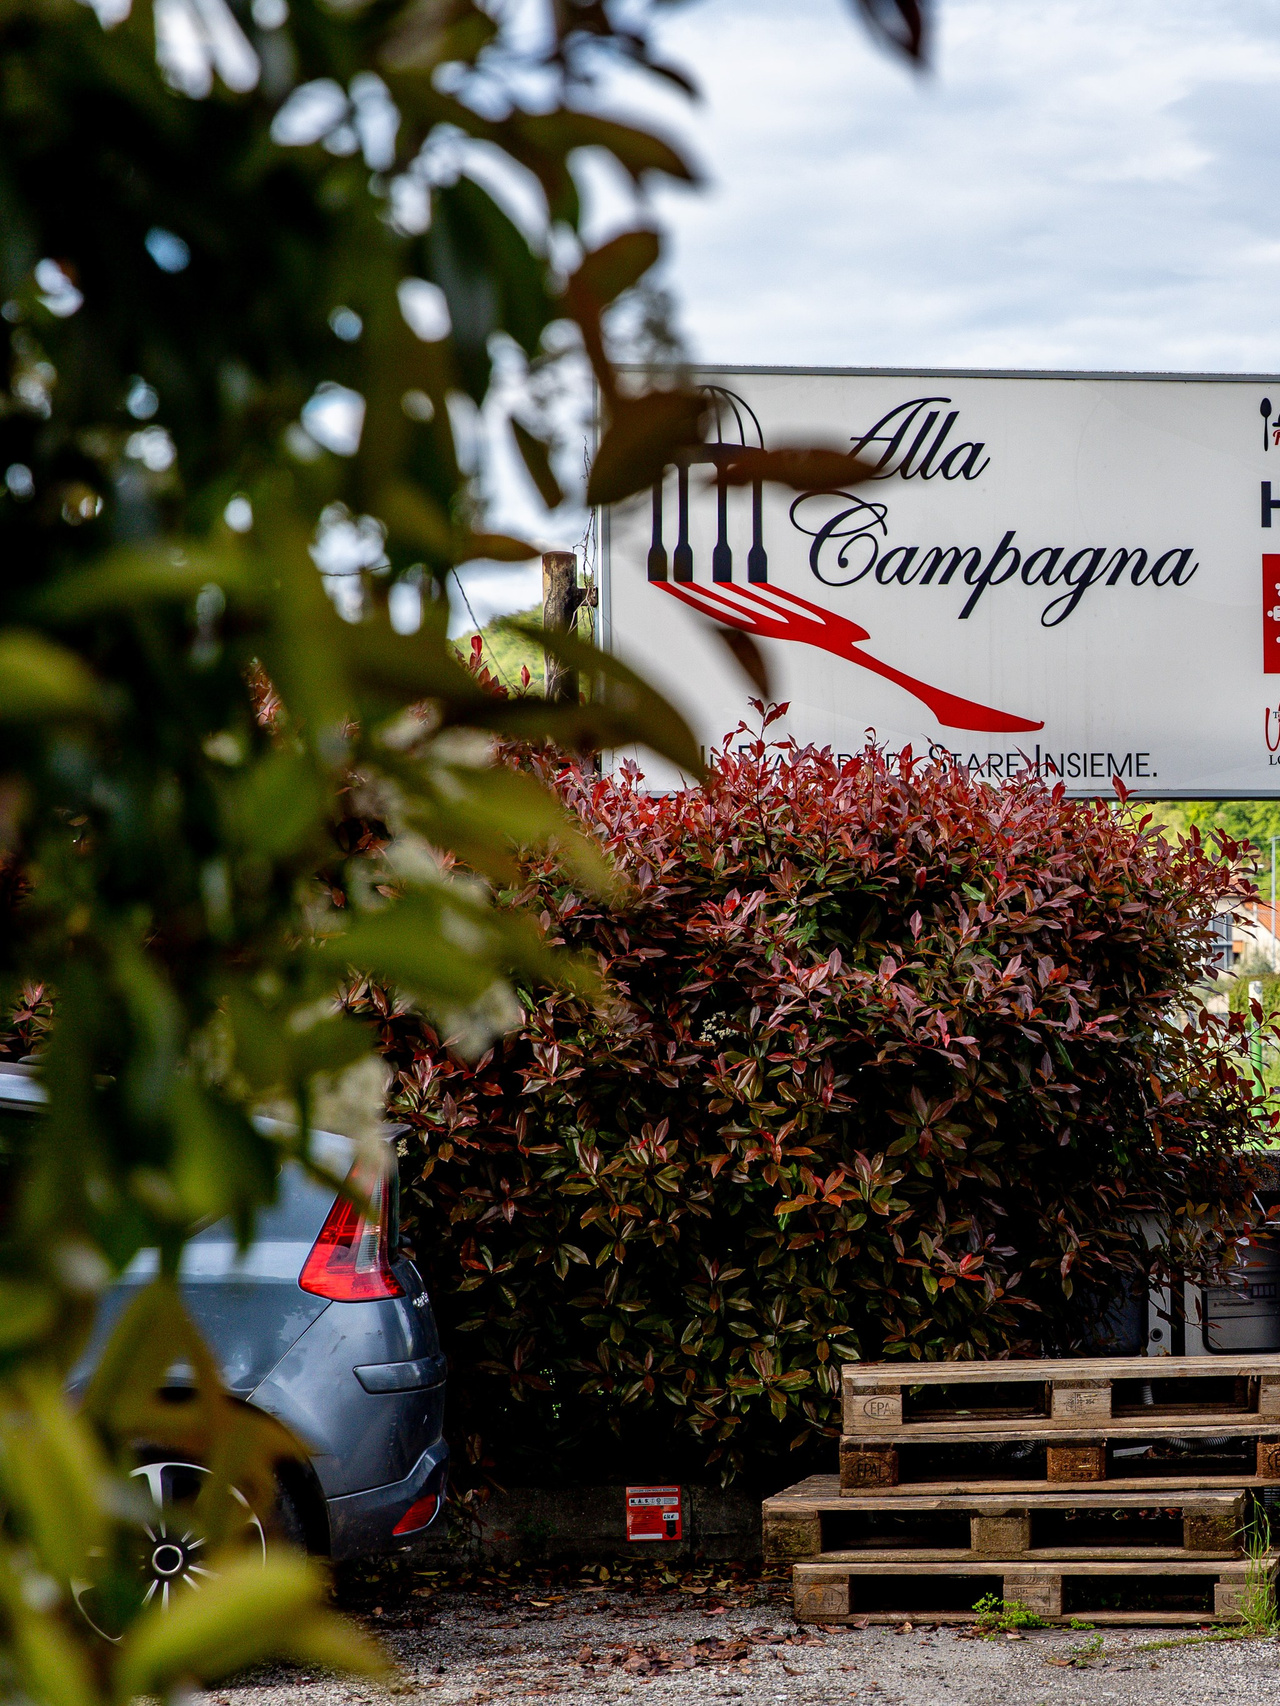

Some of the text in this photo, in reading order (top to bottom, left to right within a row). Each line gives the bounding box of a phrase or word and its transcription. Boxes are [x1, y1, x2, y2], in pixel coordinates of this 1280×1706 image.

[848, 397, 991, 481] Alla
[788, 490, 1199, 628] Campagna
[1035, 744, 1158, 778] INSIEME.
